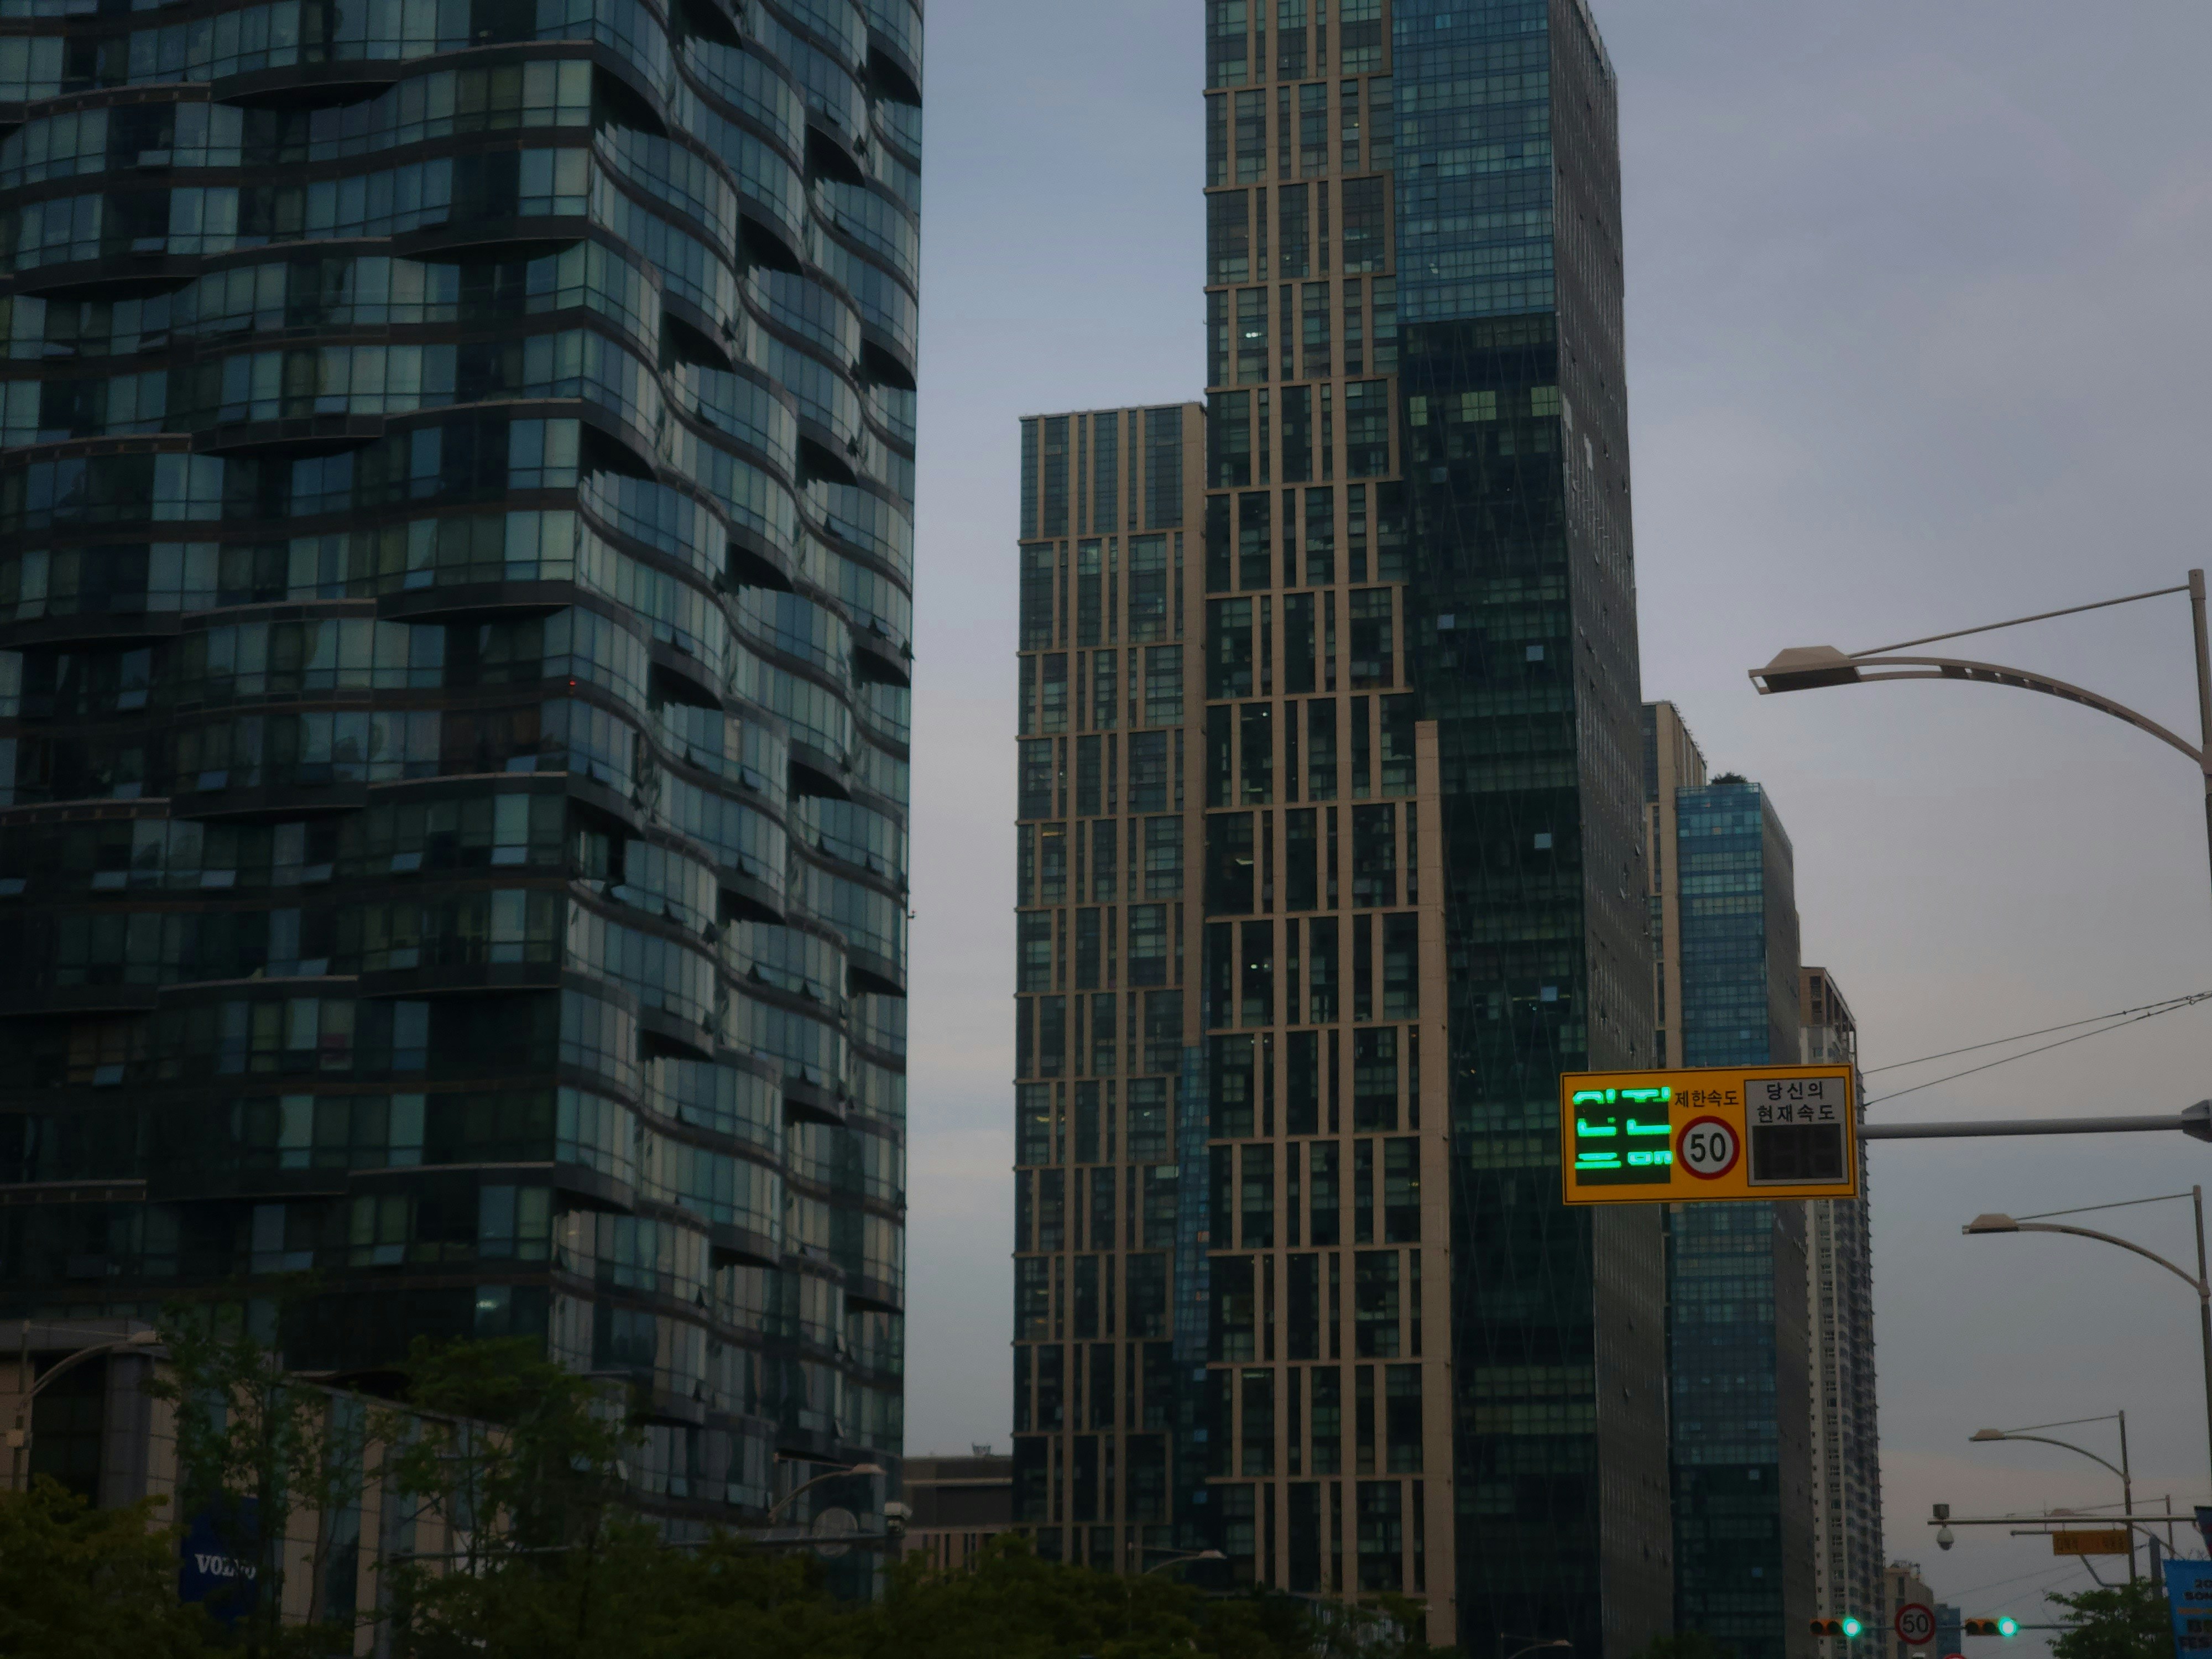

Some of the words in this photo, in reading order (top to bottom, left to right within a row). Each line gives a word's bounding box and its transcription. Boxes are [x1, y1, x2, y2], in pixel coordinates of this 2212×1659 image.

[1674, 1089, 1739, 1108] 제한속도
[1766, 1081, 1823, 1100] 당신의
[1757, 1104, 1835, 1124] 현재속도
[1690, 1133, 1725, 1162] 50
[1903, 1614, 1929, 1633] 50
